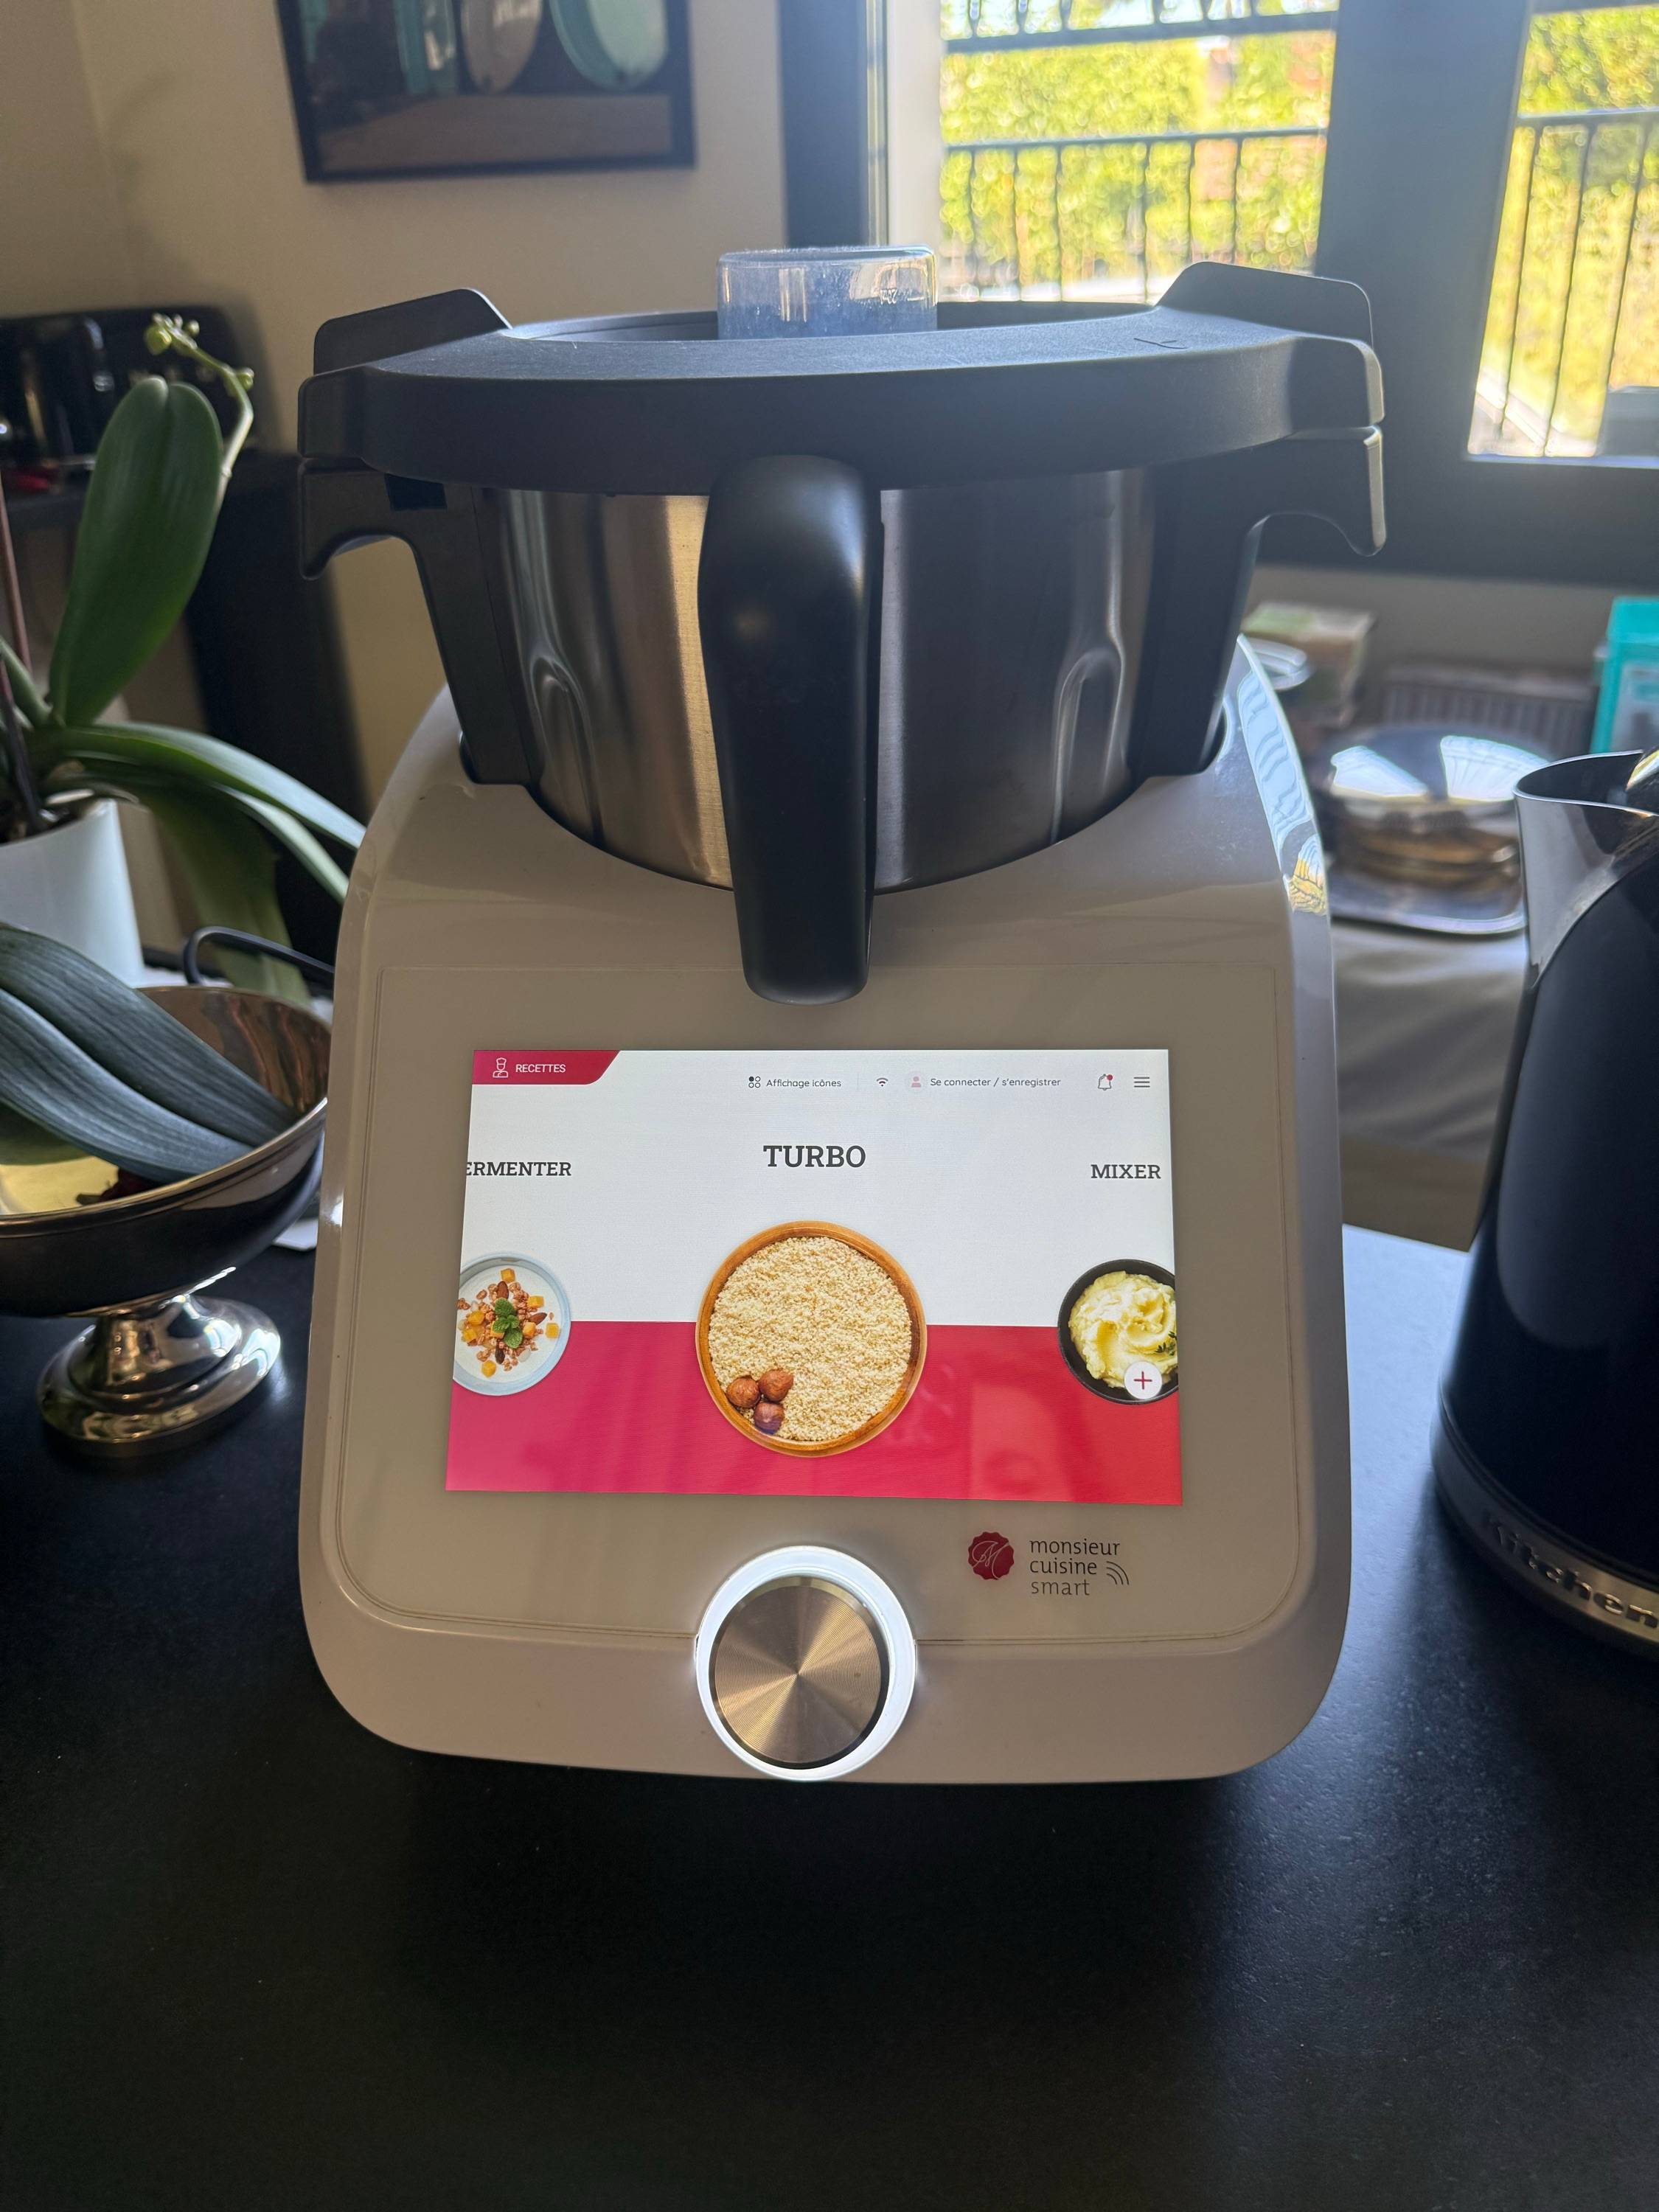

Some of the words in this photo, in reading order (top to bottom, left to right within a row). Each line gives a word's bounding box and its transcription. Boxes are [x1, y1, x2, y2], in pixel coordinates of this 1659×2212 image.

[515, 1063, 566, 1074] RECETTES
[766, 1079, 810, 1089] Affichage
[812, 1079, 842, 1087] icônes
[930, 1078, 942, 1086] Se
[944, 1078, 991, 1086] connecter
[1001, 1078, 1061, 1088] s'enregistrer
[763, 1145, 866, 1168] TURBO
[1091, 1164, 1161, 1179] MIXER
[1029, 1538, 1121, 1556] monsieur
[1029, 1557, 1097, 1575] cuisine
[1031, 1579, 1091, 1596] smart
